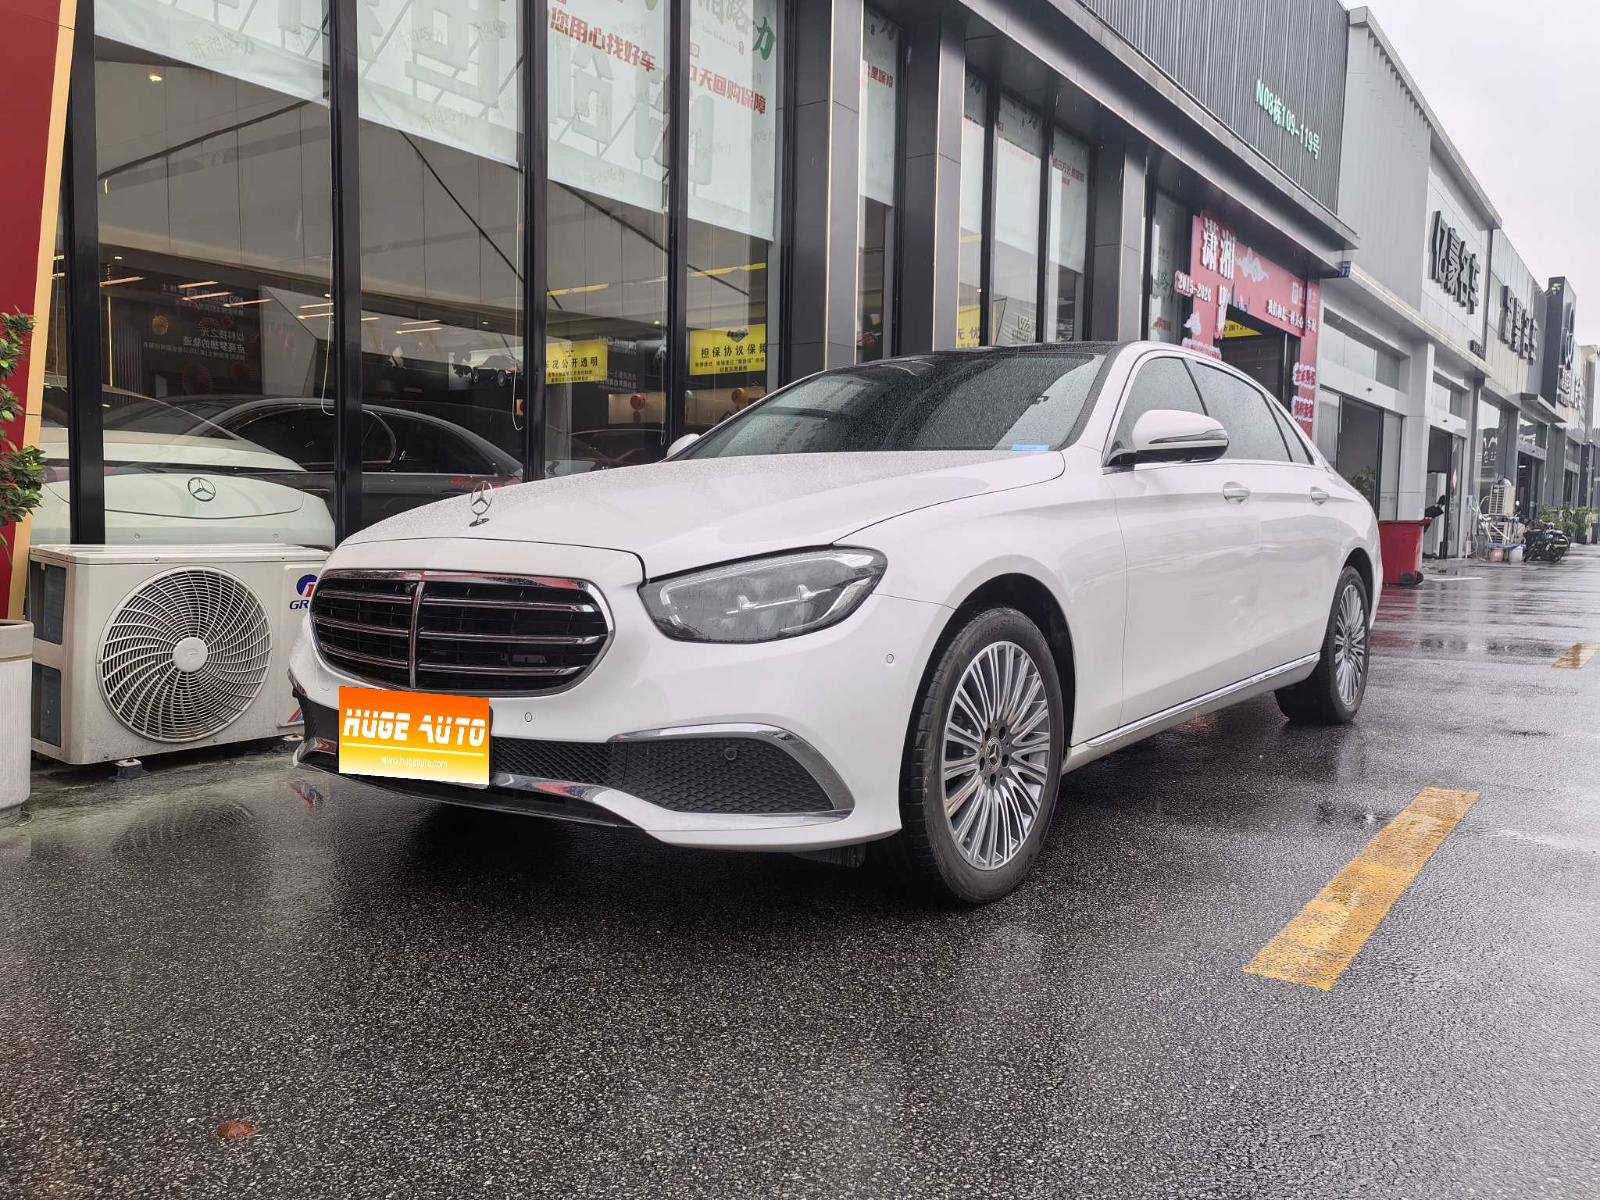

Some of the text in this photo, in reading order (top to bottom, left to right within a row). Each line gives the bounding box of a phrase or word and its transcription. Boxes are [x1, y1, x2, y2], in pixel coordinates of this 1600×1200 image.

[550, 7, 656, 72] 您用心找好车
[1256, 79, 1320, 160] N08栋109-119号
[1428, 210, 1481, 315] 亿豪名车
